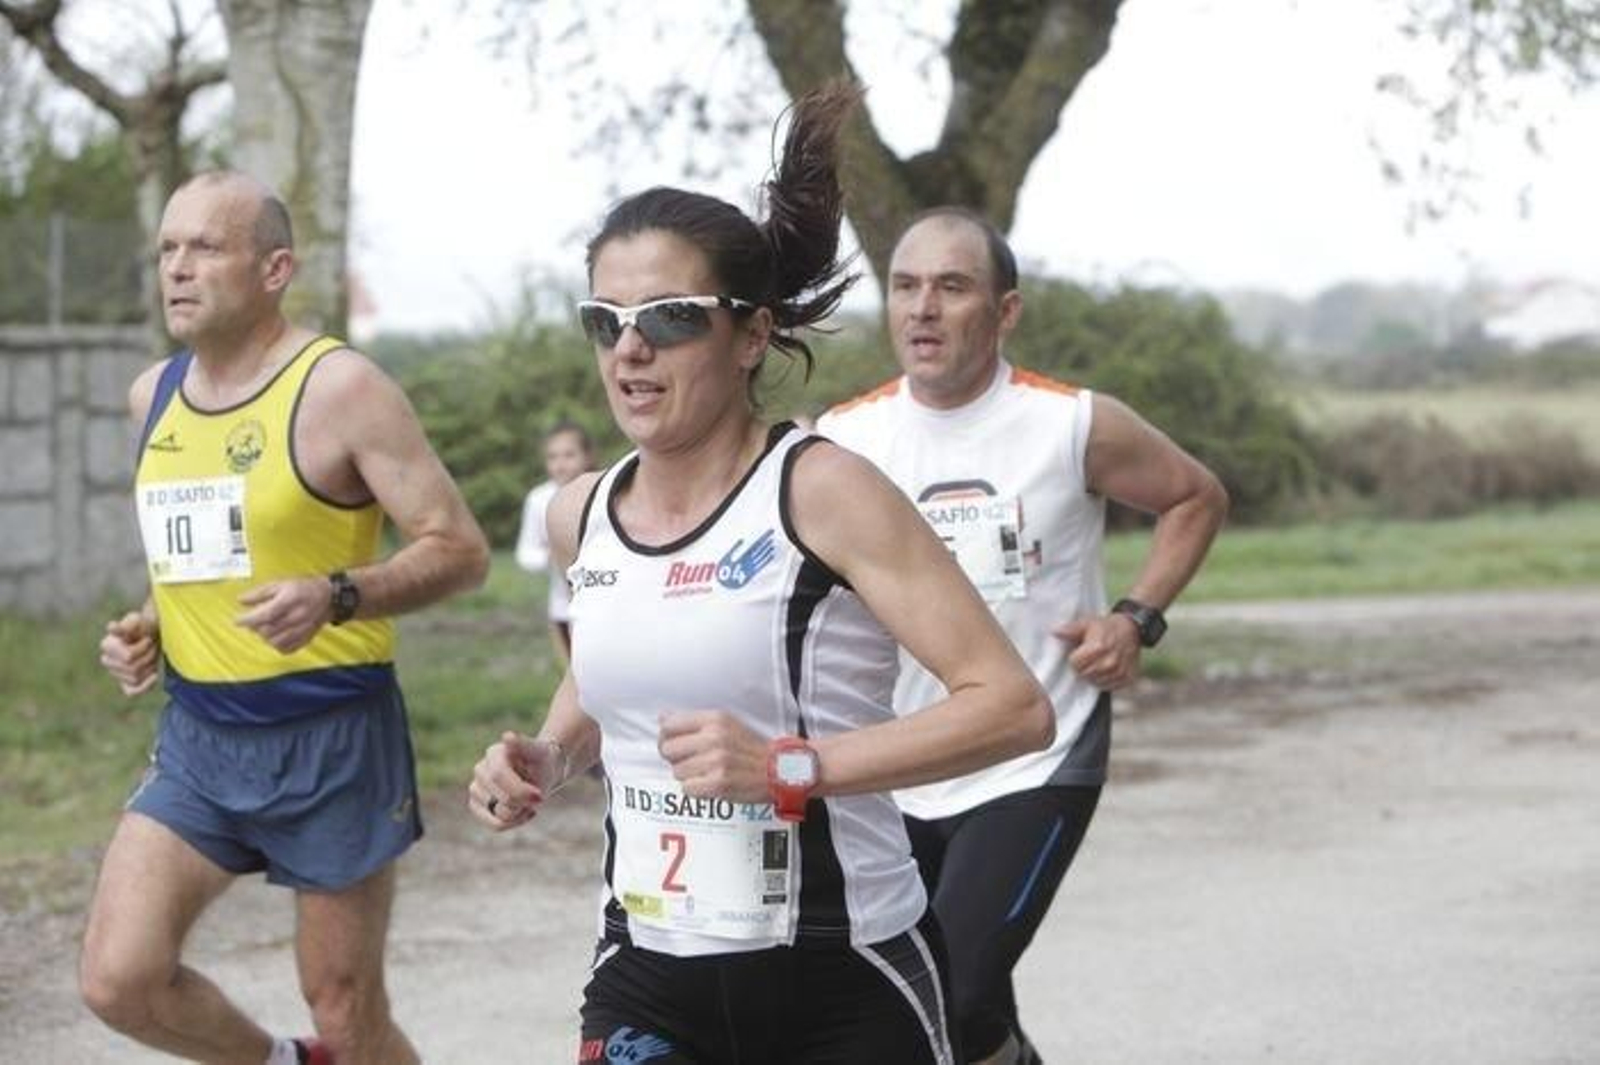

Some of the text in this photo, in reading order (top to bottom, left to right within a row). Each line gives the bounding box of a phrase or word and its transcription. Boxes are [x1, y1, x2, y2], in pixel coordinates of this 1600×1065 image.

[165, 514, 193, 555] 10
[665, 560, 716, 587] Run
[660, 832, 687, 893] 2
